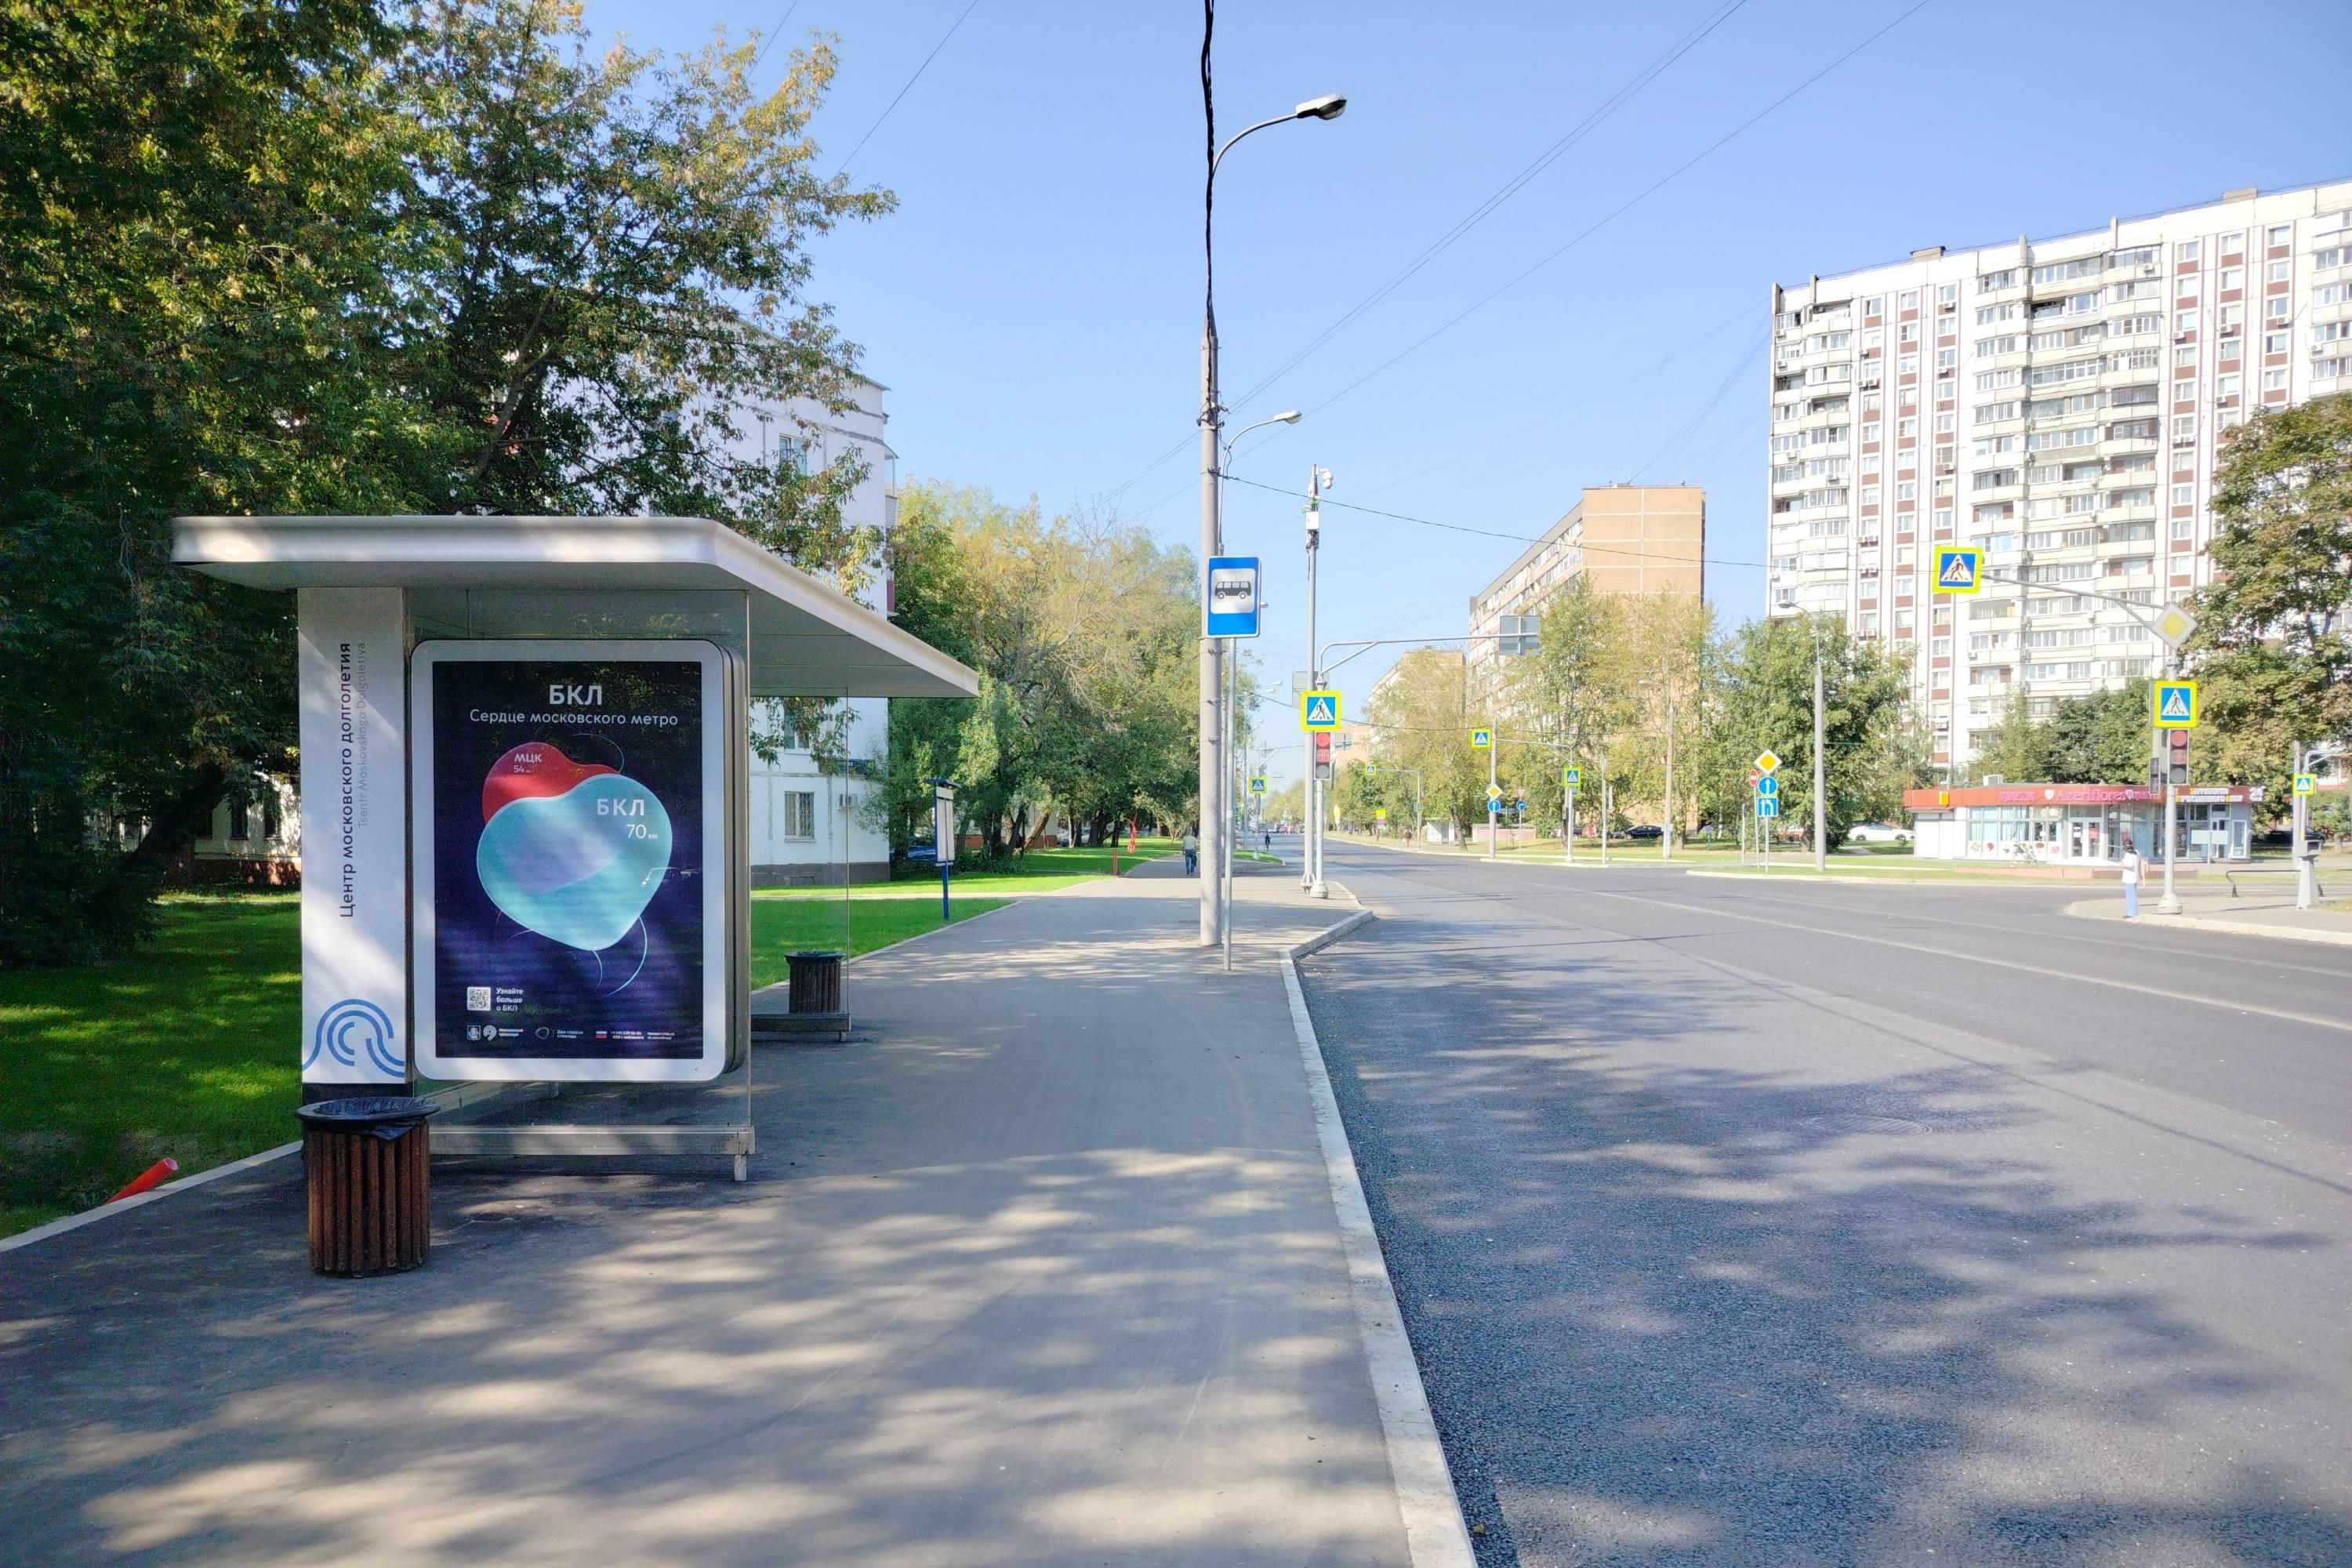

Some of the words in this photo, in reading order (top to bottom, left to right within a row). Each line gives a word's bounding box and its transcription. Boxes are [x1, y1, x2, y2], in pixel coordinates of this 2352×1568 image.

[340, 643, 354, 743] долголетия
[549, 684, 602, 705] БКЛ
[470, 709, 525, 723] Сердце
[530, 713, 626, 724] московского
[630, 714, 678, 728] метро
[357, 712, 368, 791] Moskovskogo
[514, 753, 543, 764] МЦК
[514, 764, 524, 773] 54
[342, 748, 354, 858] московского
[358, 794, 368, 828] Tsentr
[596, 798, 645, 816] БКЛ
[626, 824, 647, 839] 70
[339, 864, 356, 917] Центр
